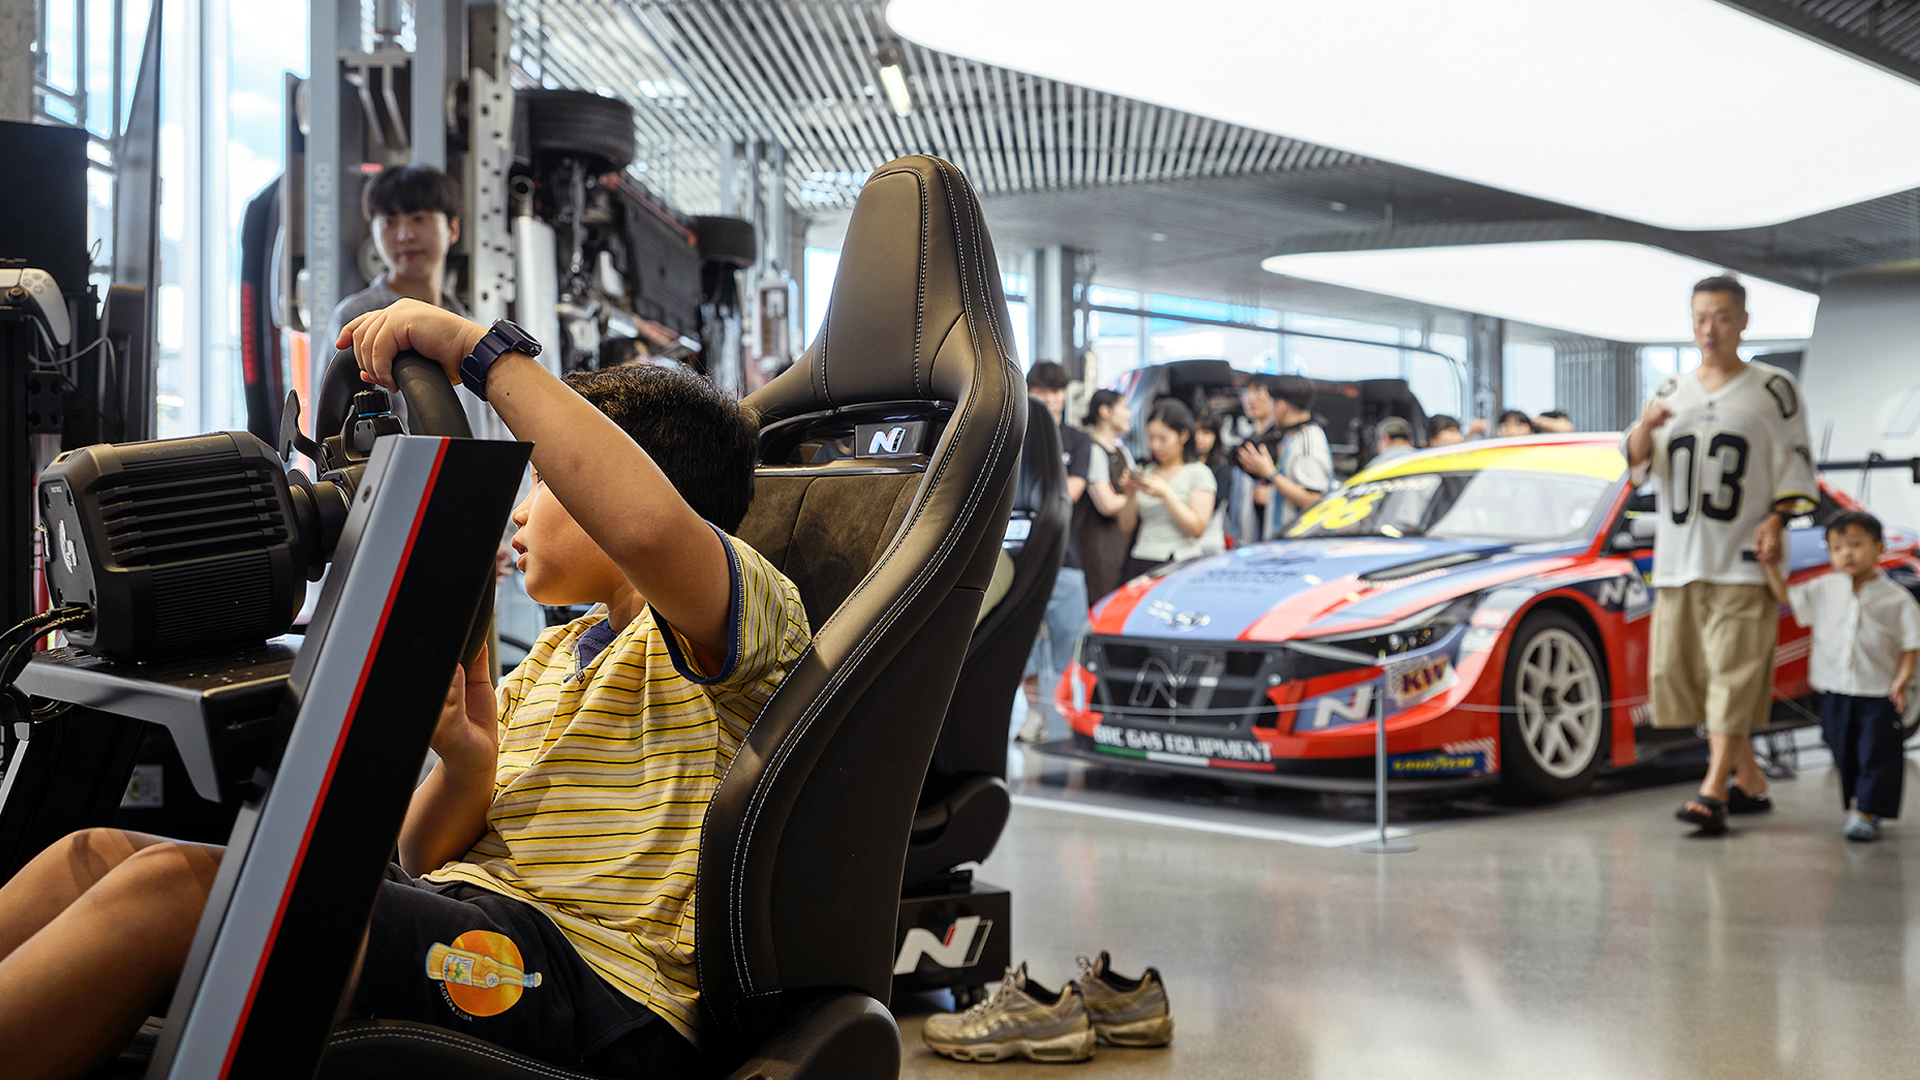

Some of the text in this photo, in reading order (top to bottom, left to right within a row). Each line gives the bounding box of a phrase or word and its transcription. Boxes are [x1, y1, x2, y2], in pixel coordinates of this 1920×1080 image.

[313, 162, 333, 197] DO
[313, 204, 333, 250] NOT
[1667, 433, 1748, 525] 03
[1401, 657, 1450, 695] KW
[1126, 728, 1163, 751] GAS
[1164, 733, 1273, 763] EQUIPMENT
